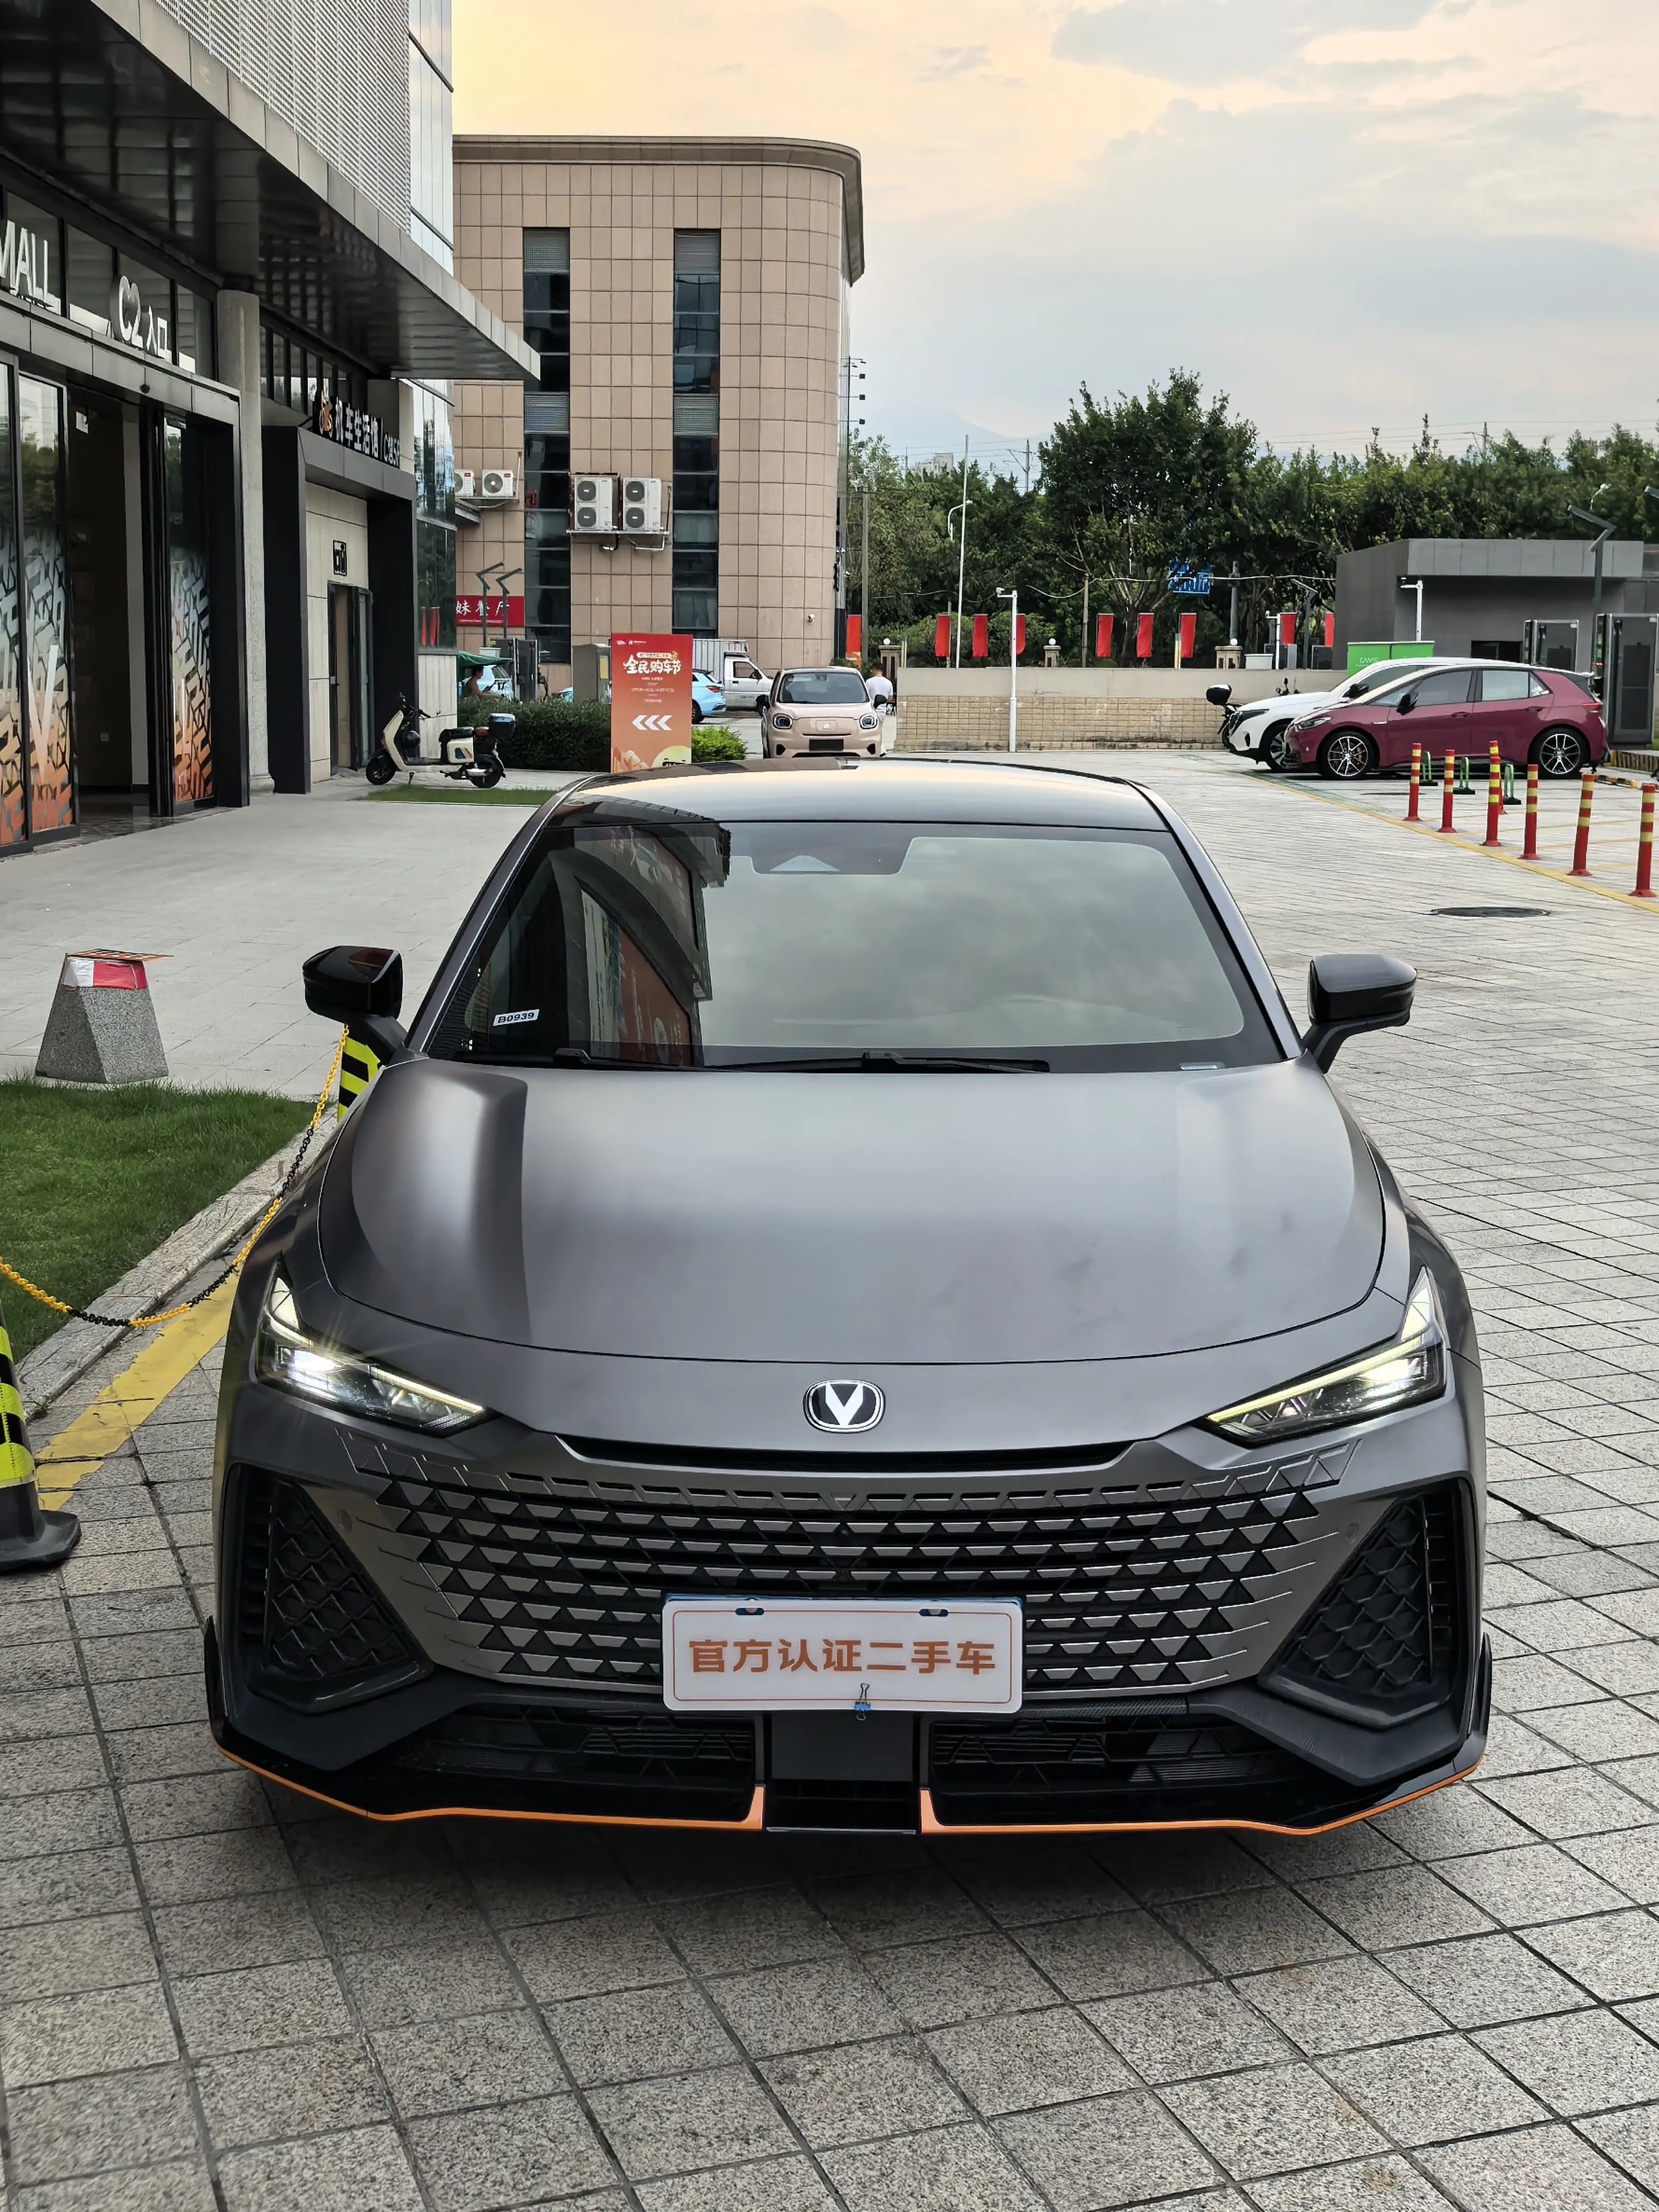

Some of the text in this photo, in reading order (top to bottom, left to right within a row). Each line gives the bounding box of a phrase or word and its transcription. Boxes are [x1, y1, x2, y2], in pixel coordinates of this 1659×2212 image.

[623, 655, 682, 675] 全民购车节
[498, 1012, 535, 1023] B0939
[689, 1638, 995, 1675] 官方认证二手车
